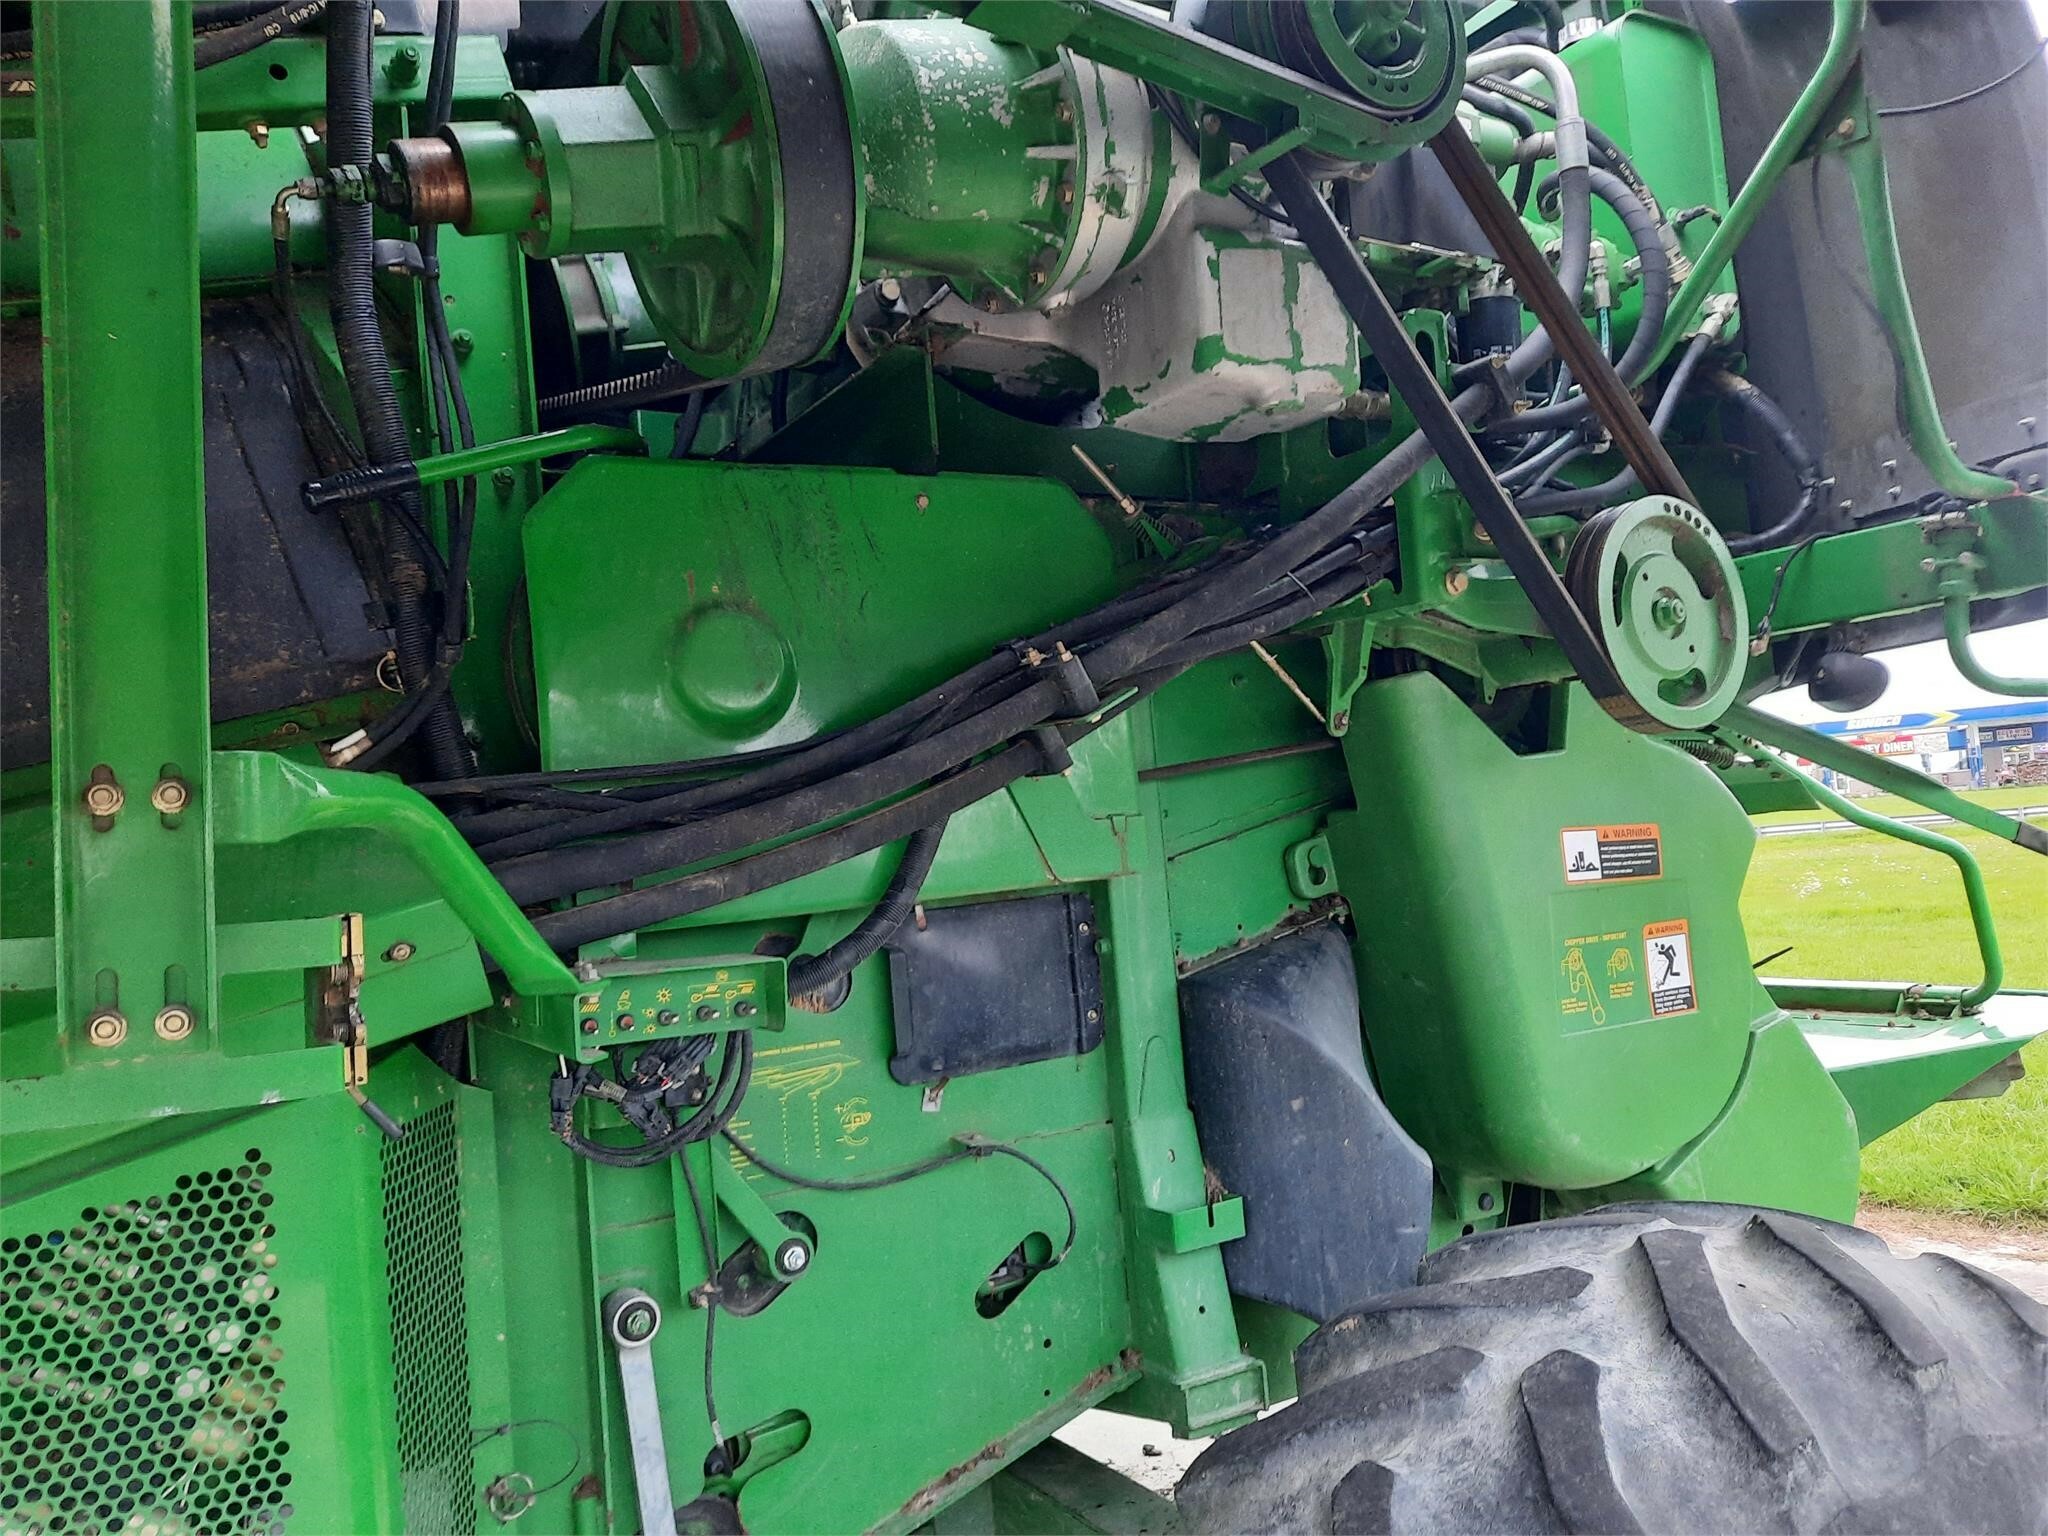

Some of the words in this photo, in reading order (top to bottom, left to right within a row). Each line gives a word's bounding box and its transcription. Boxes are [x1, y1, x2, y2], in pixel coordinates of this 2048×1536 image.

[1883, 740, 1914, 753] DINER
[1612, 827, 1652, 839] WARNING
[1655, 923, 1684, 934] WARNING
